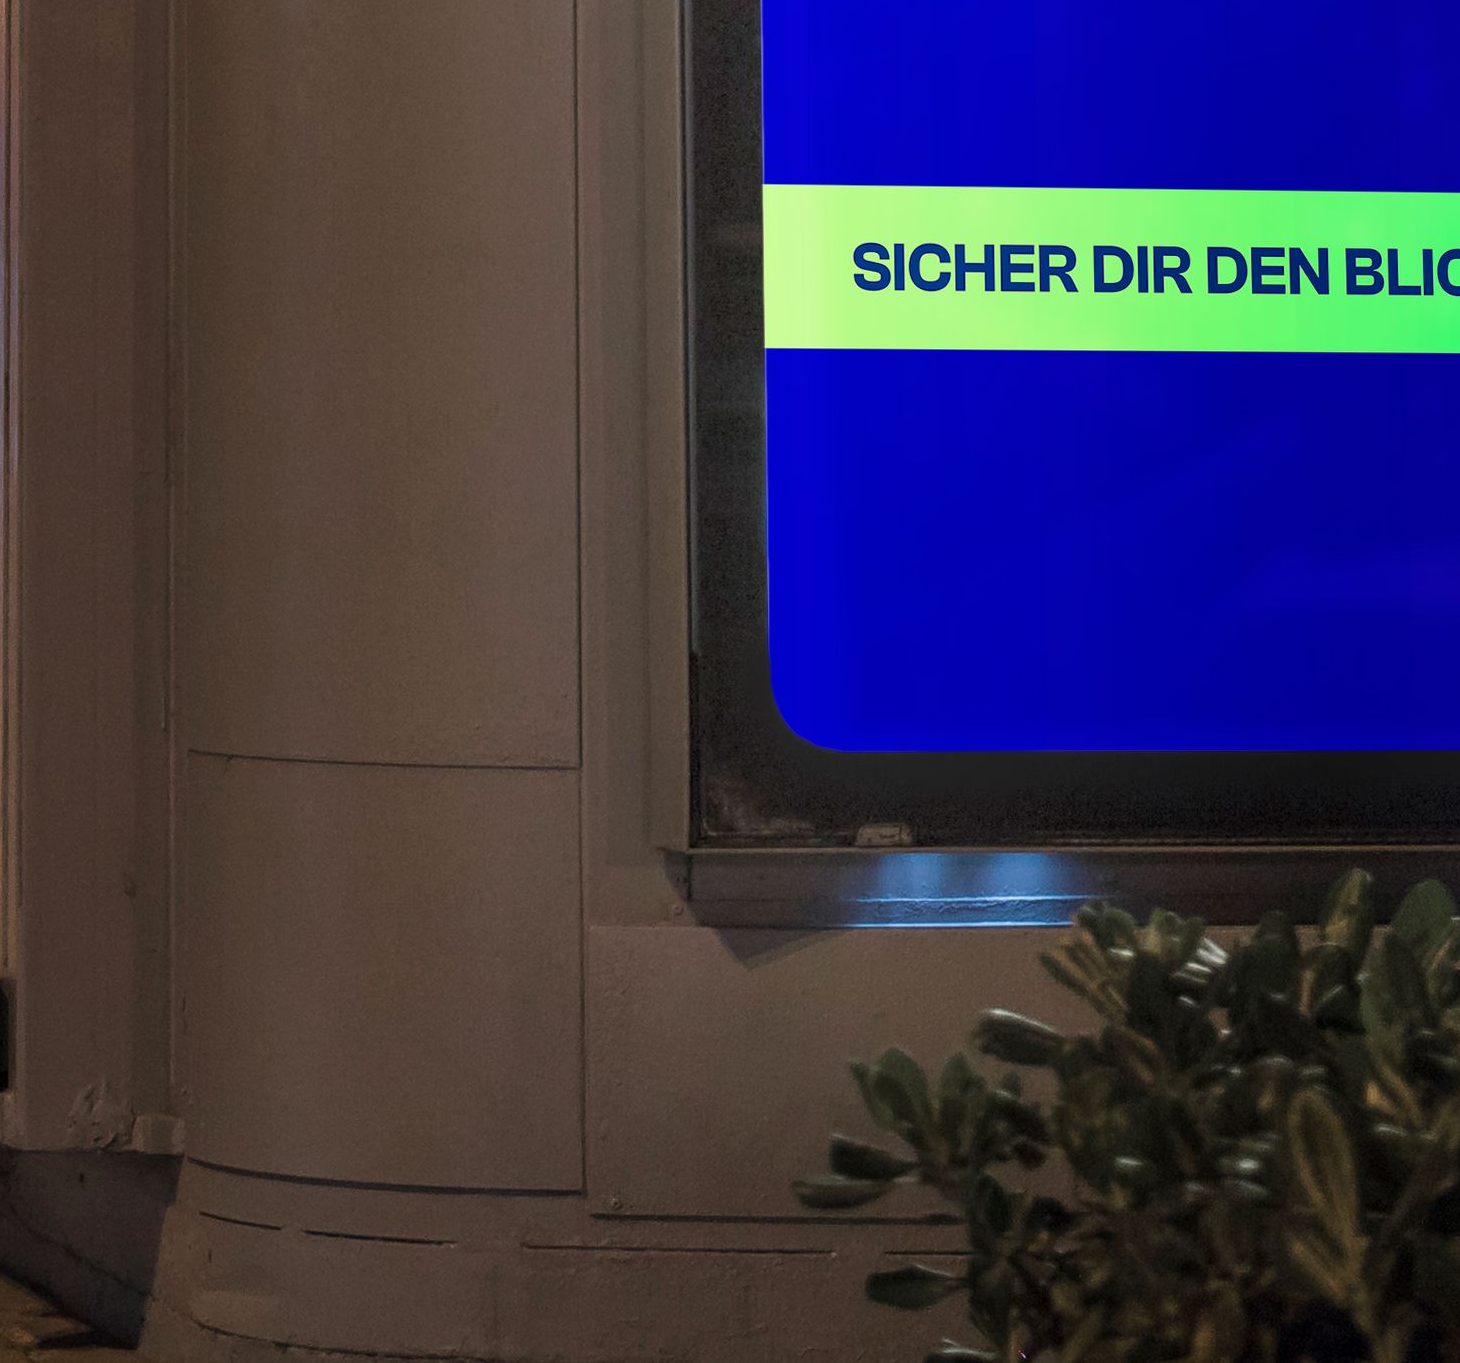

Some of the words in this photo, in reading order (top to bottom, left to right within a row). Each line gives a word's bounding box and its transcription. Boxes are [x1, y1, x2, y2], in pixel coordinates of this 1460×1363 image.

[853, 242, 1079, 293] SICHER
[1093, 245, 1193, 294] DIR
[1206, 246, 1330, 295] DEN
